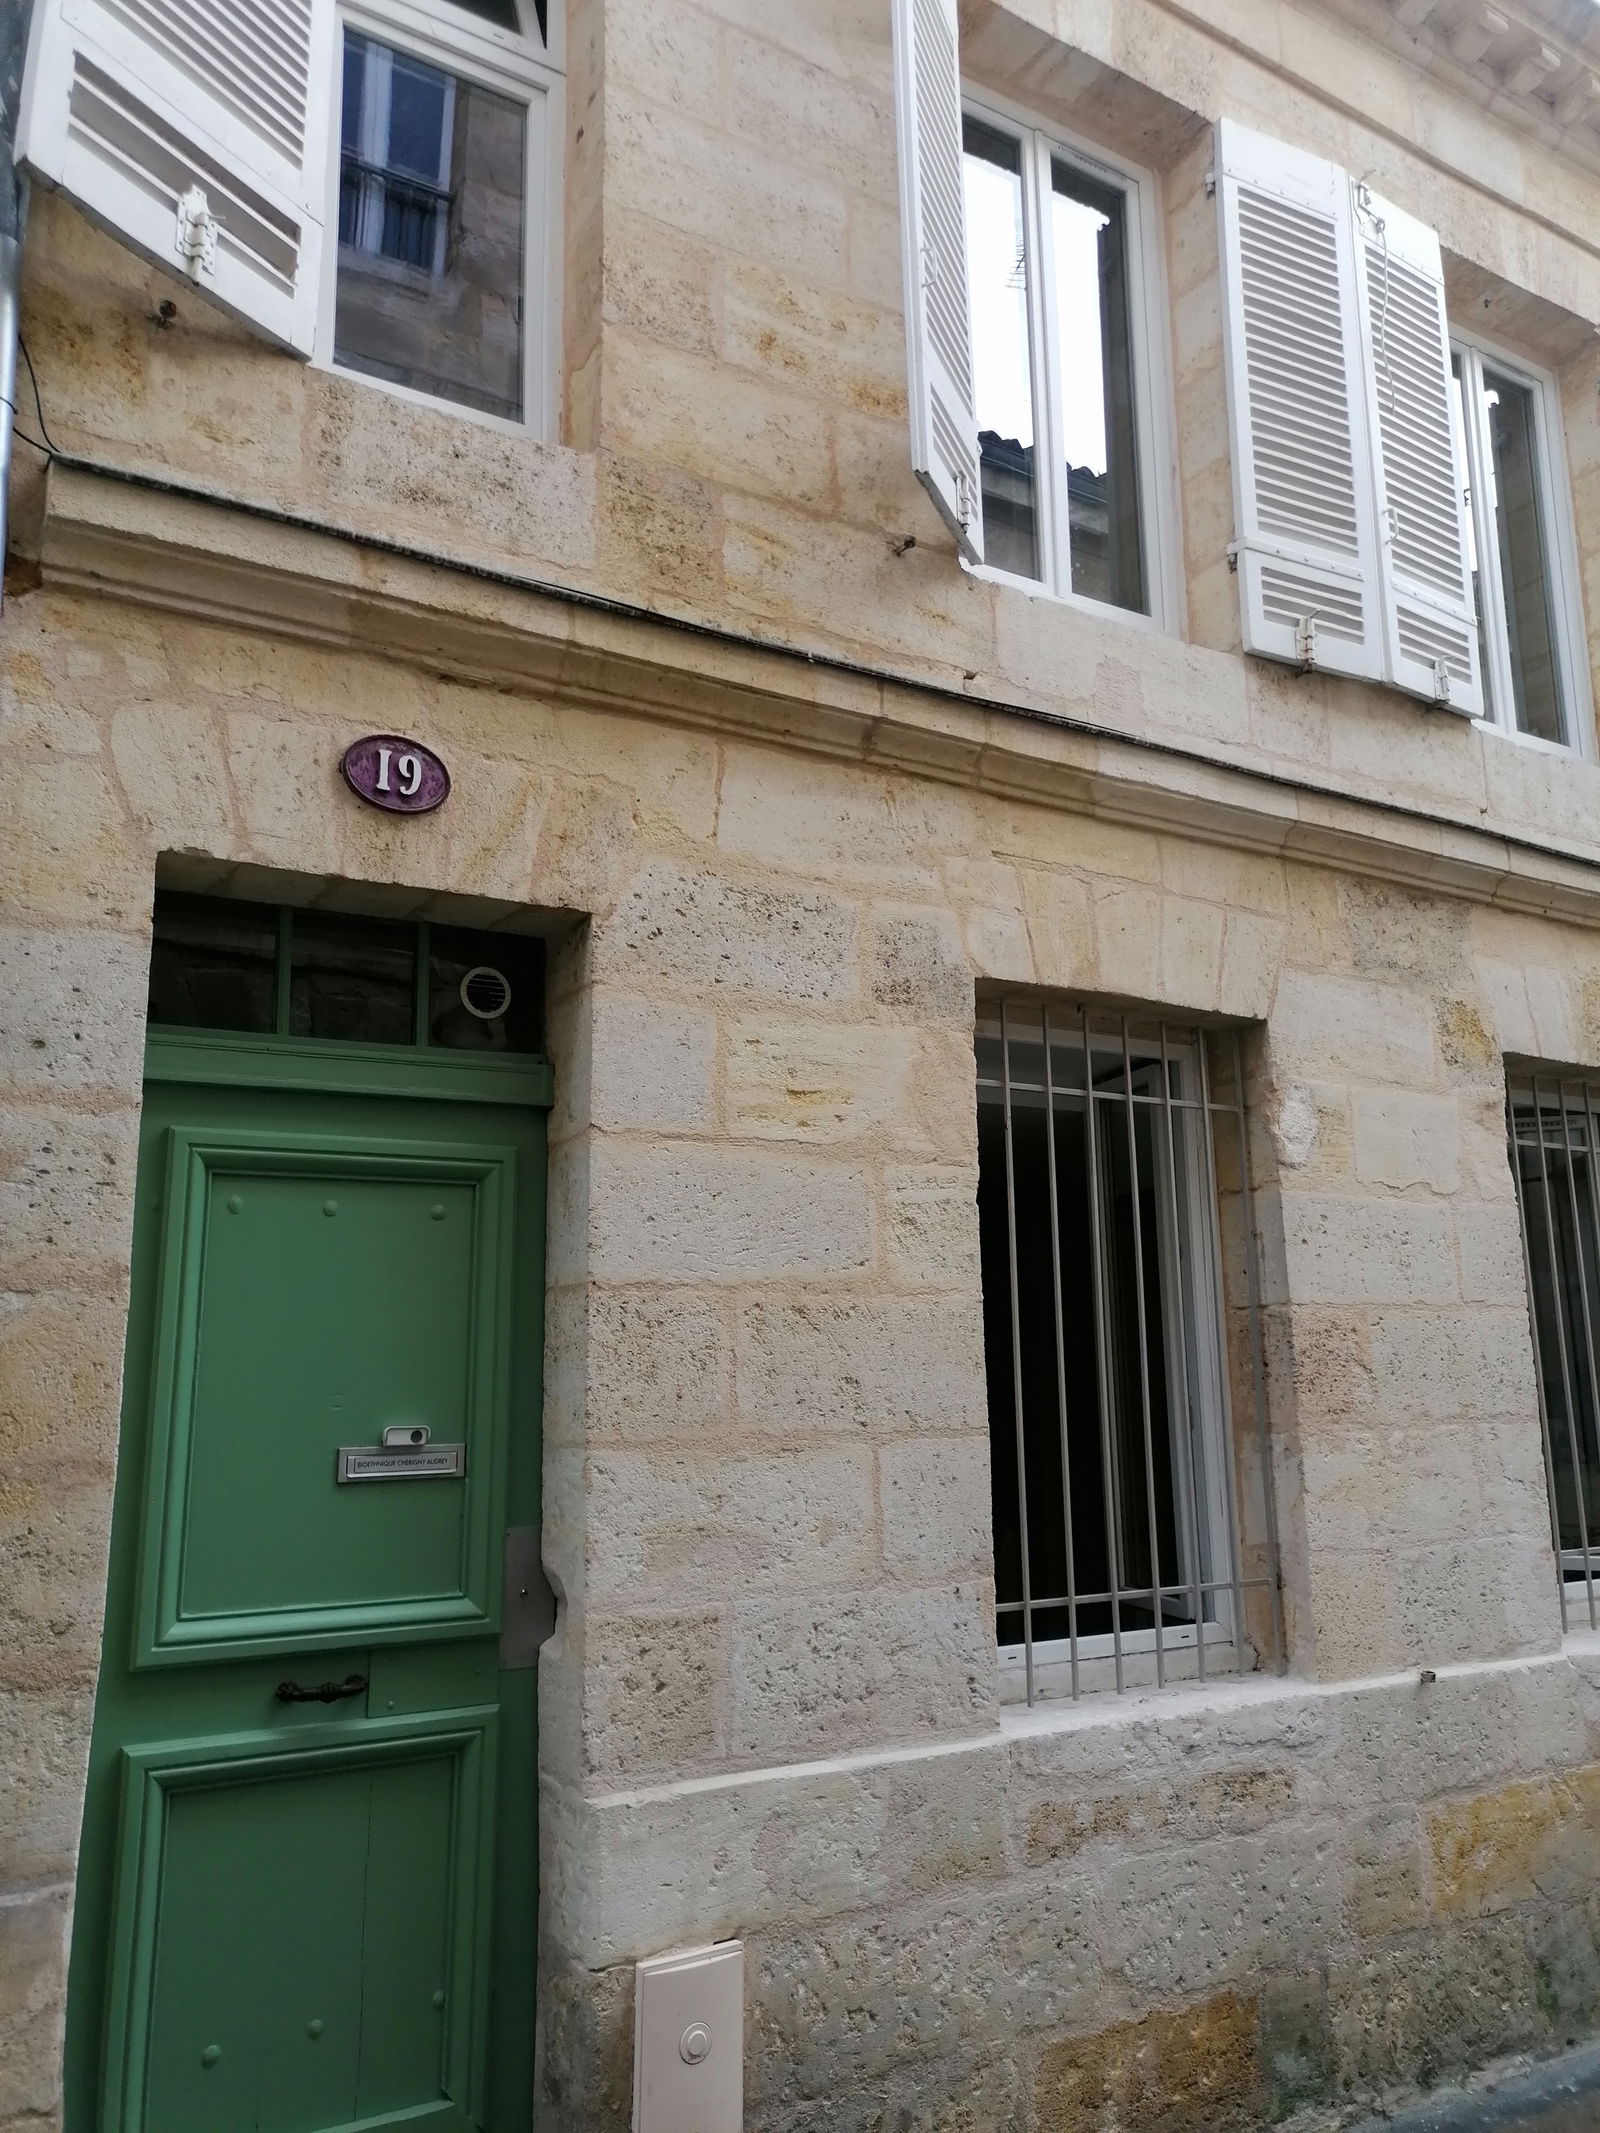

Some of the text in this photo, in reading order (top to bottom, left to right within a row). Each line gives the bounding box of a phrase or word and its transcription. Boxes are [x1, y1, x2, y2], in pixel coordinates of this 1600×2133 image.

[376, 749, 422, 795] 19
[357, 1457, 449, 1469] BIOETHNIQUE CHERIGNY AUDREY
